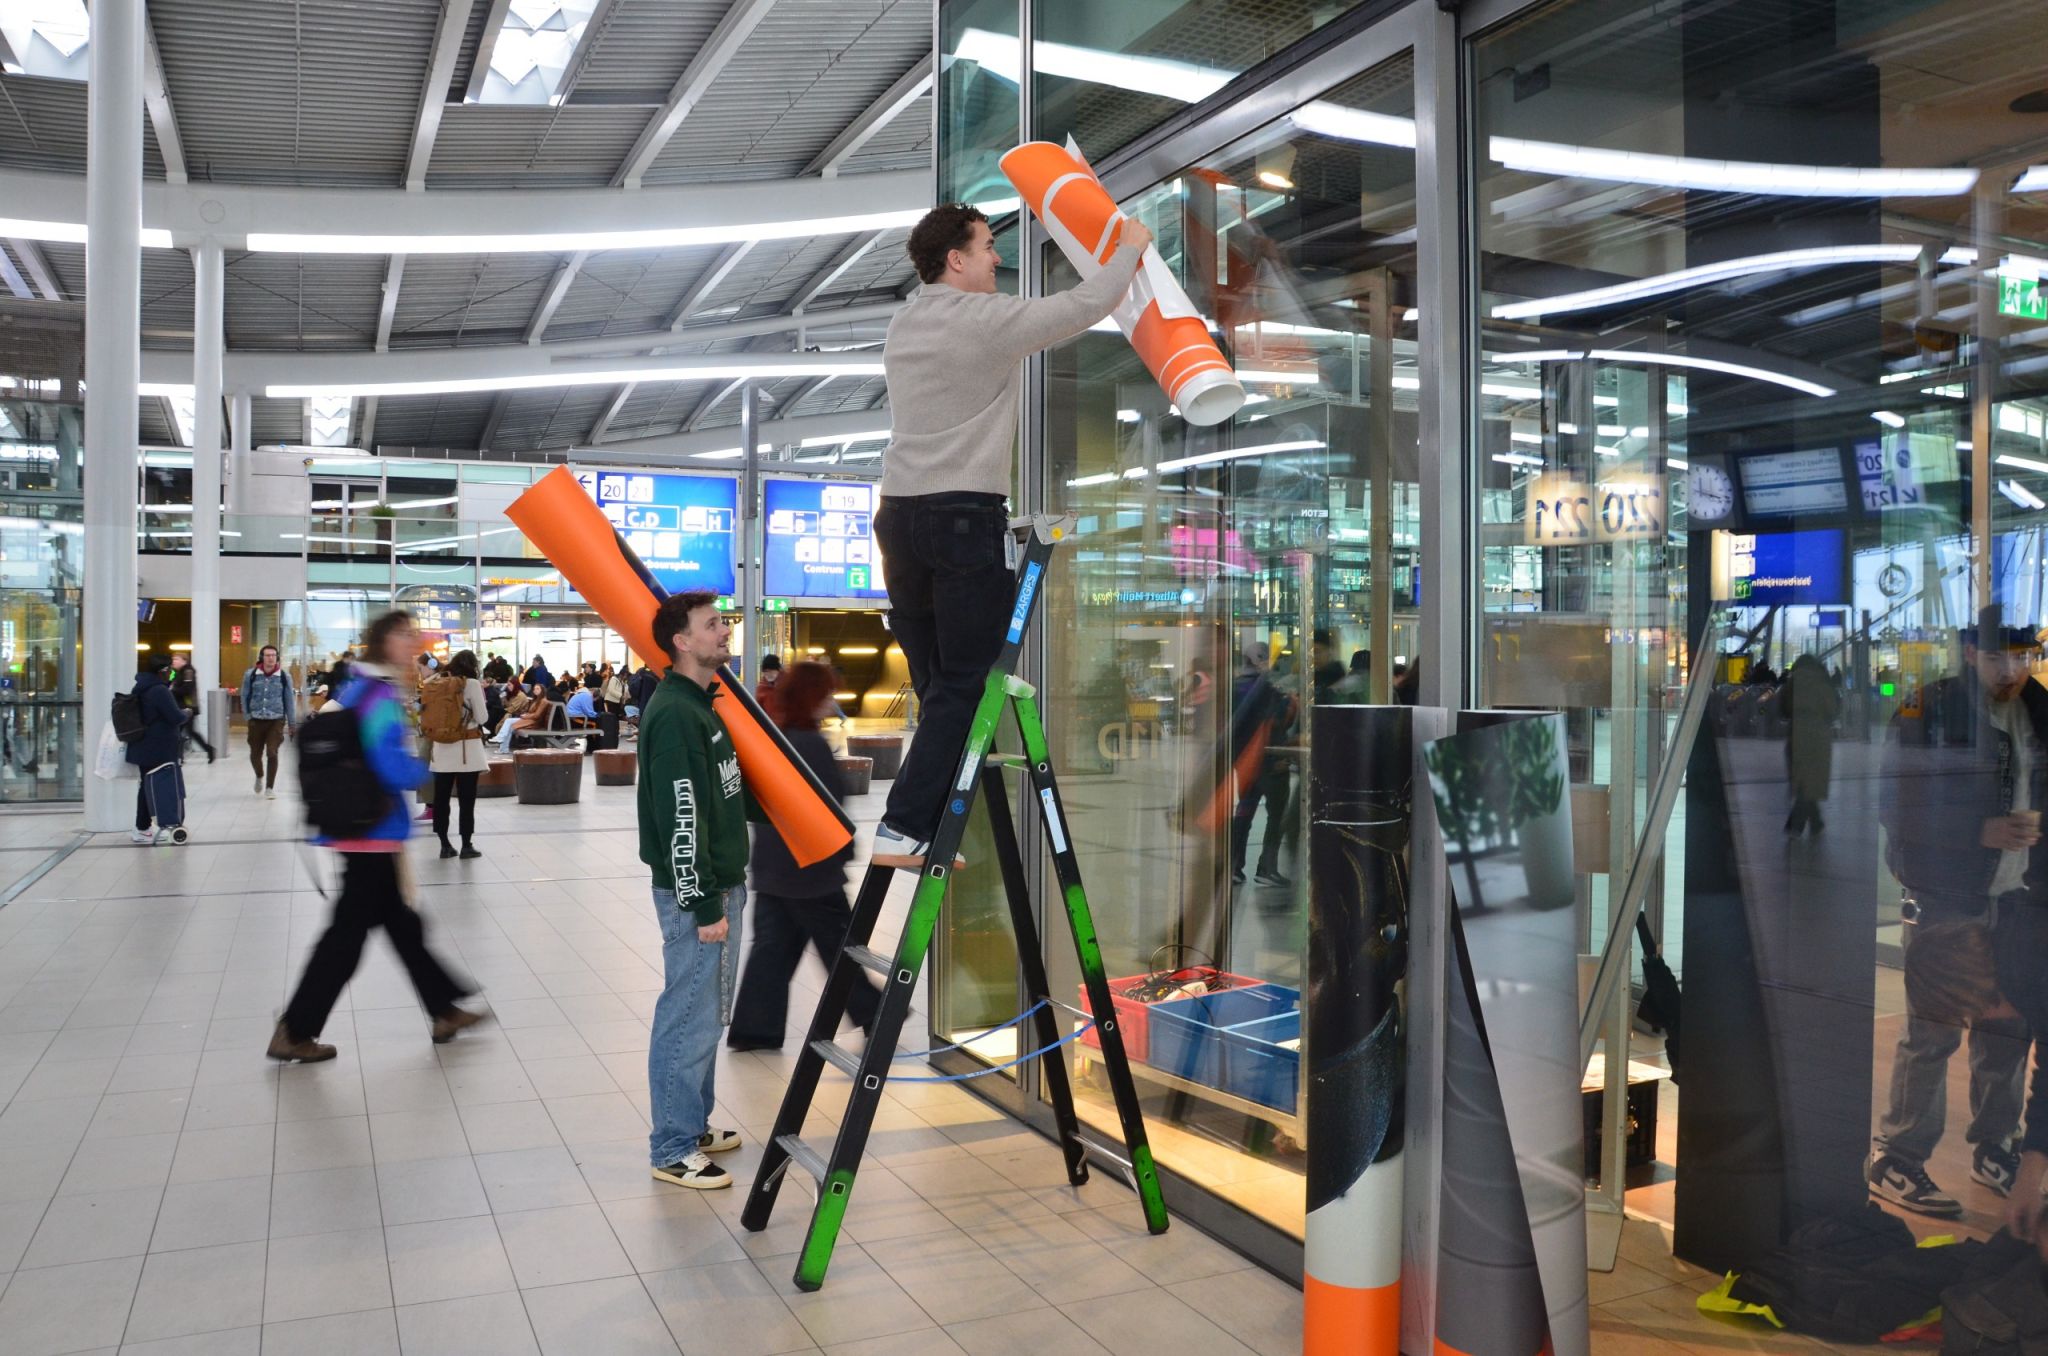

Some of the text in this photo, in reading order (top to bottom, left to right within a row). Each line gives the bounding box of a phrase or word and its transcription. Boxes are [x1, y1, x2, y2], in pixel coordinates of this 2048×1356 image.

[603, 484, 621, 498] 20
[708, 514, 721, 531] H
[847, 521, 859, 535] A
[803, 564, 845, 574] Centrum
[1015, 574, 1036, 618] ZARGES
